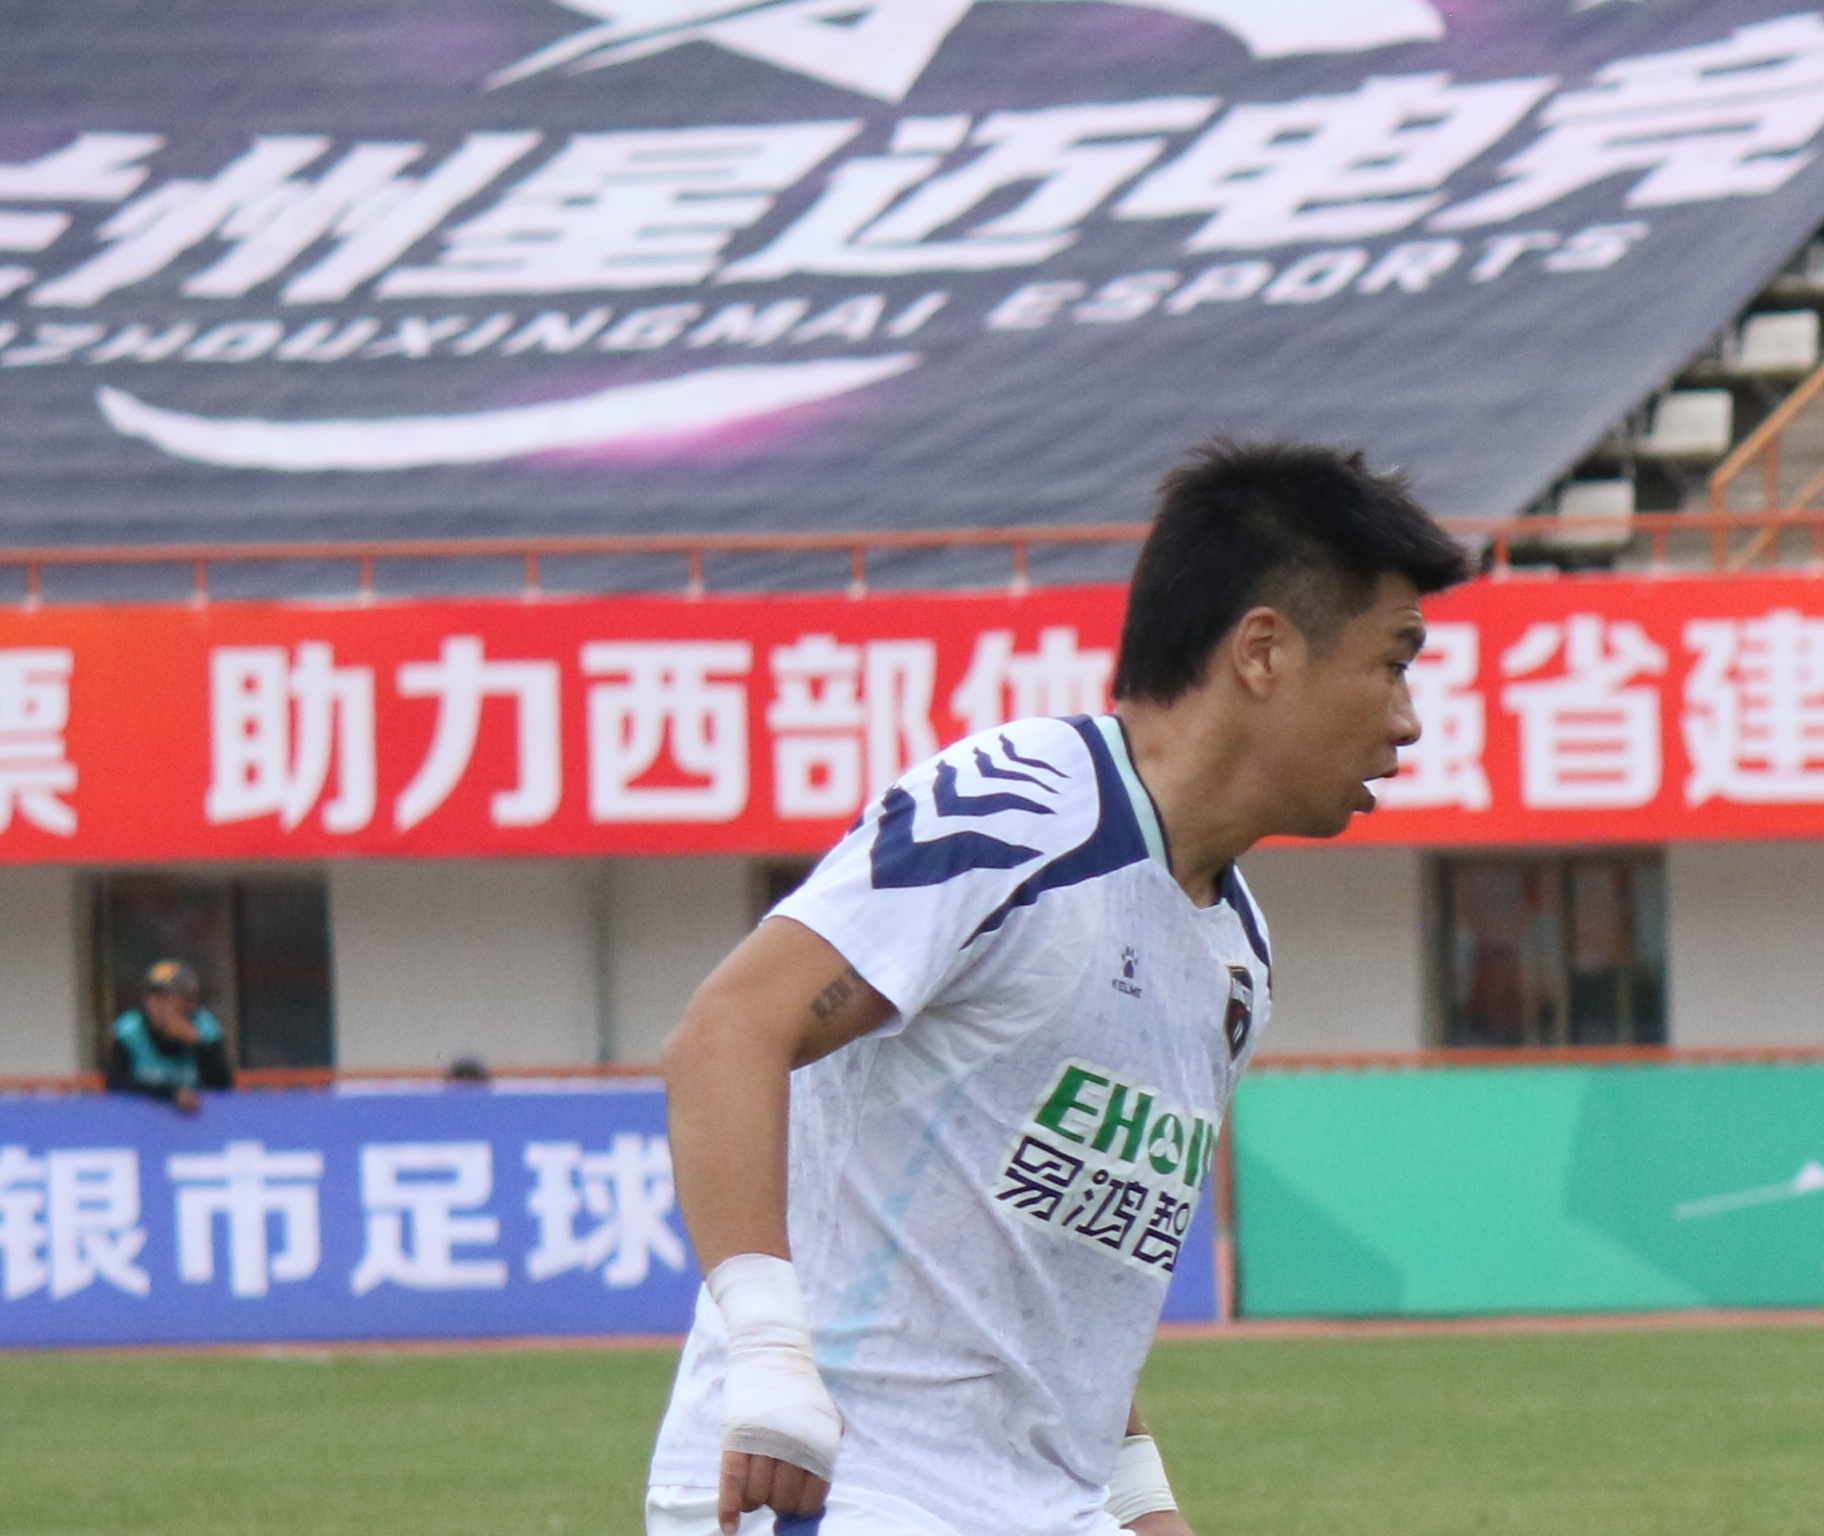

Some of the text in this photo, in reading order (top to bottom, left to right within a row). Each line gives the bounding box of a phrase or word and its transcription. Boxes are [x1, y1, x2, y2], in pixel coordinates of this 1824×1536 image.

[0, 220, 1650, 368] ZHOUXINGMAI ESPORTS
[0, 1132, 688, 1300] 银市足球
